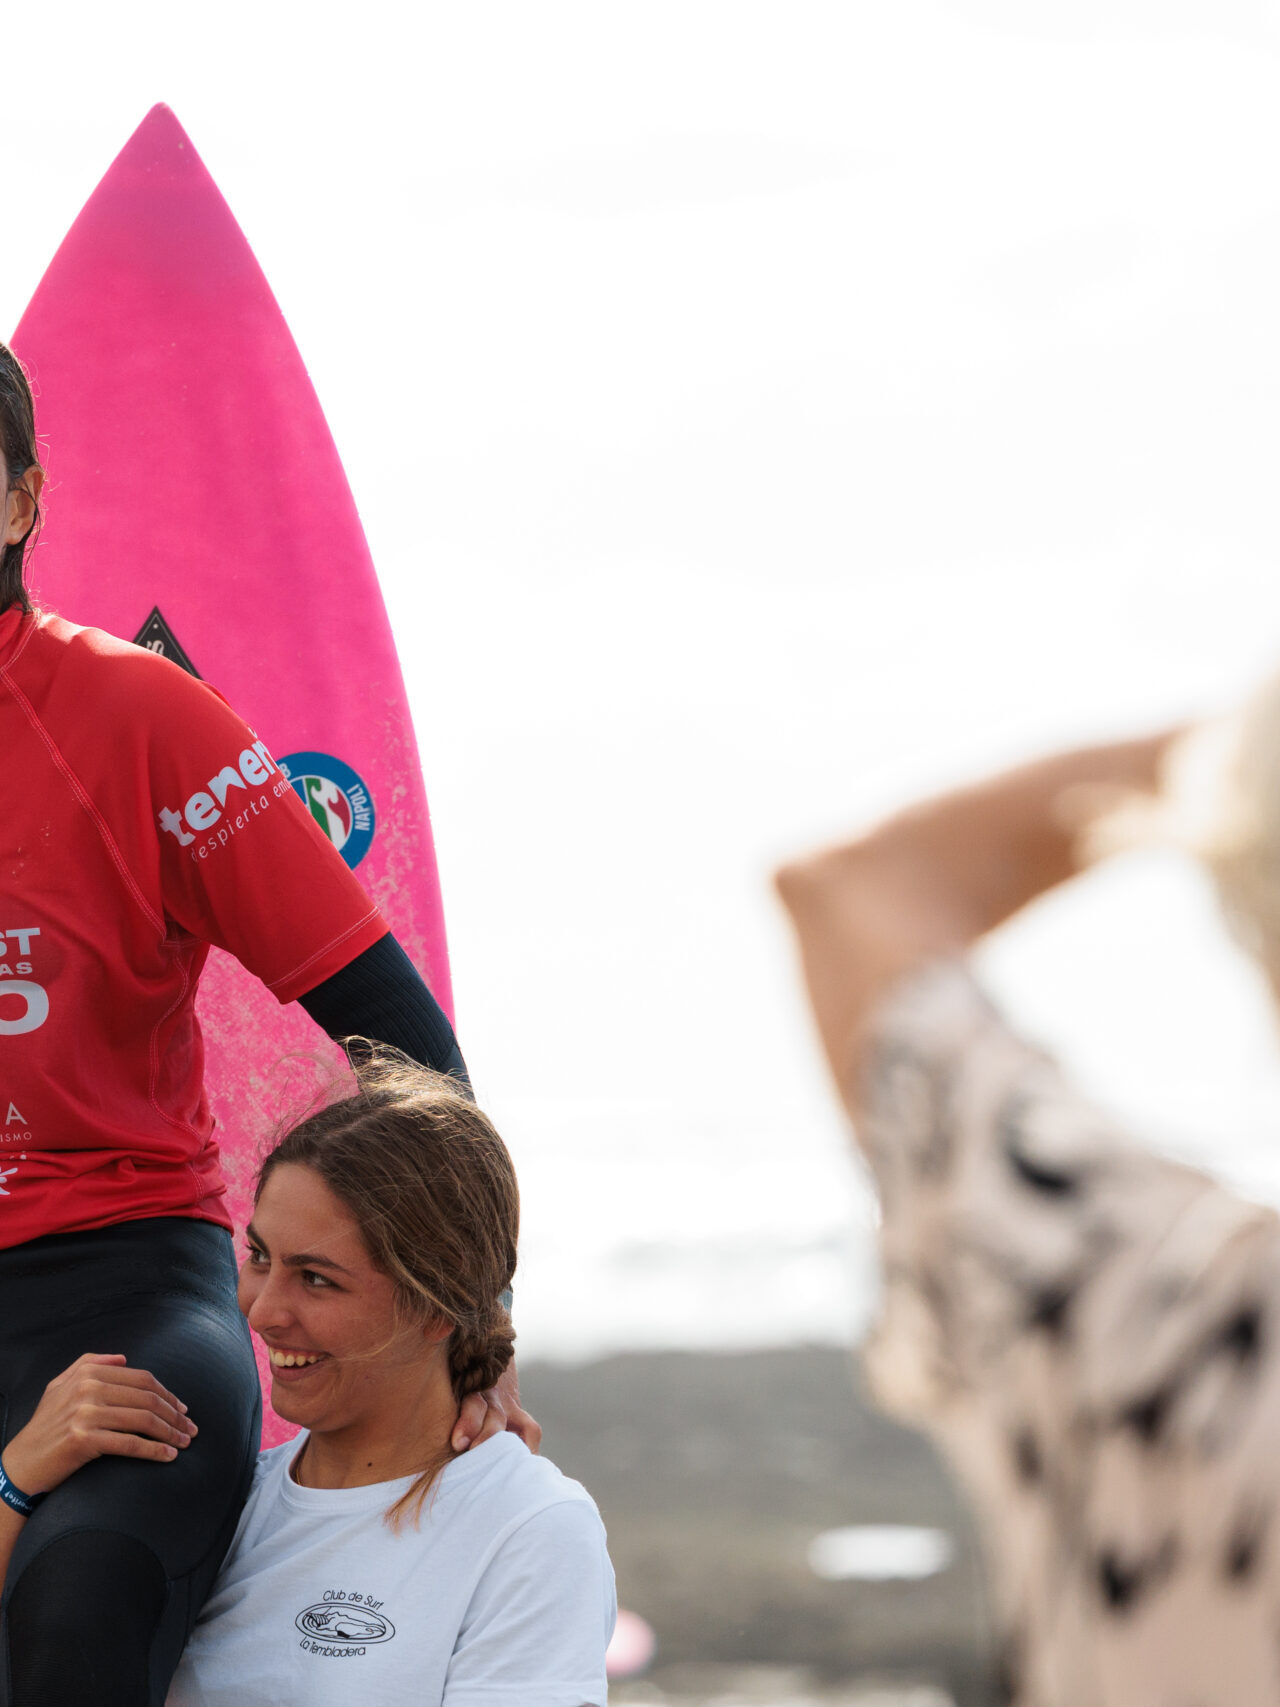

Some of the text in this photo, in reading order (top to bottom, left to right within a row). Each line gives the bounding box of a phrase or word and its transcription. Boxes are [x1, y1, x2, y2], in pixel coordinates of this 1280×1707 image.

[158, 738, 280, 847] tener
[346, 783, 370, 831] NAPOLI
[191, 795, 269, 862] despierta
[322, 1589, 384, 1610] Club de Surf
[300, 1636, 366, 1658] La Tembladera
